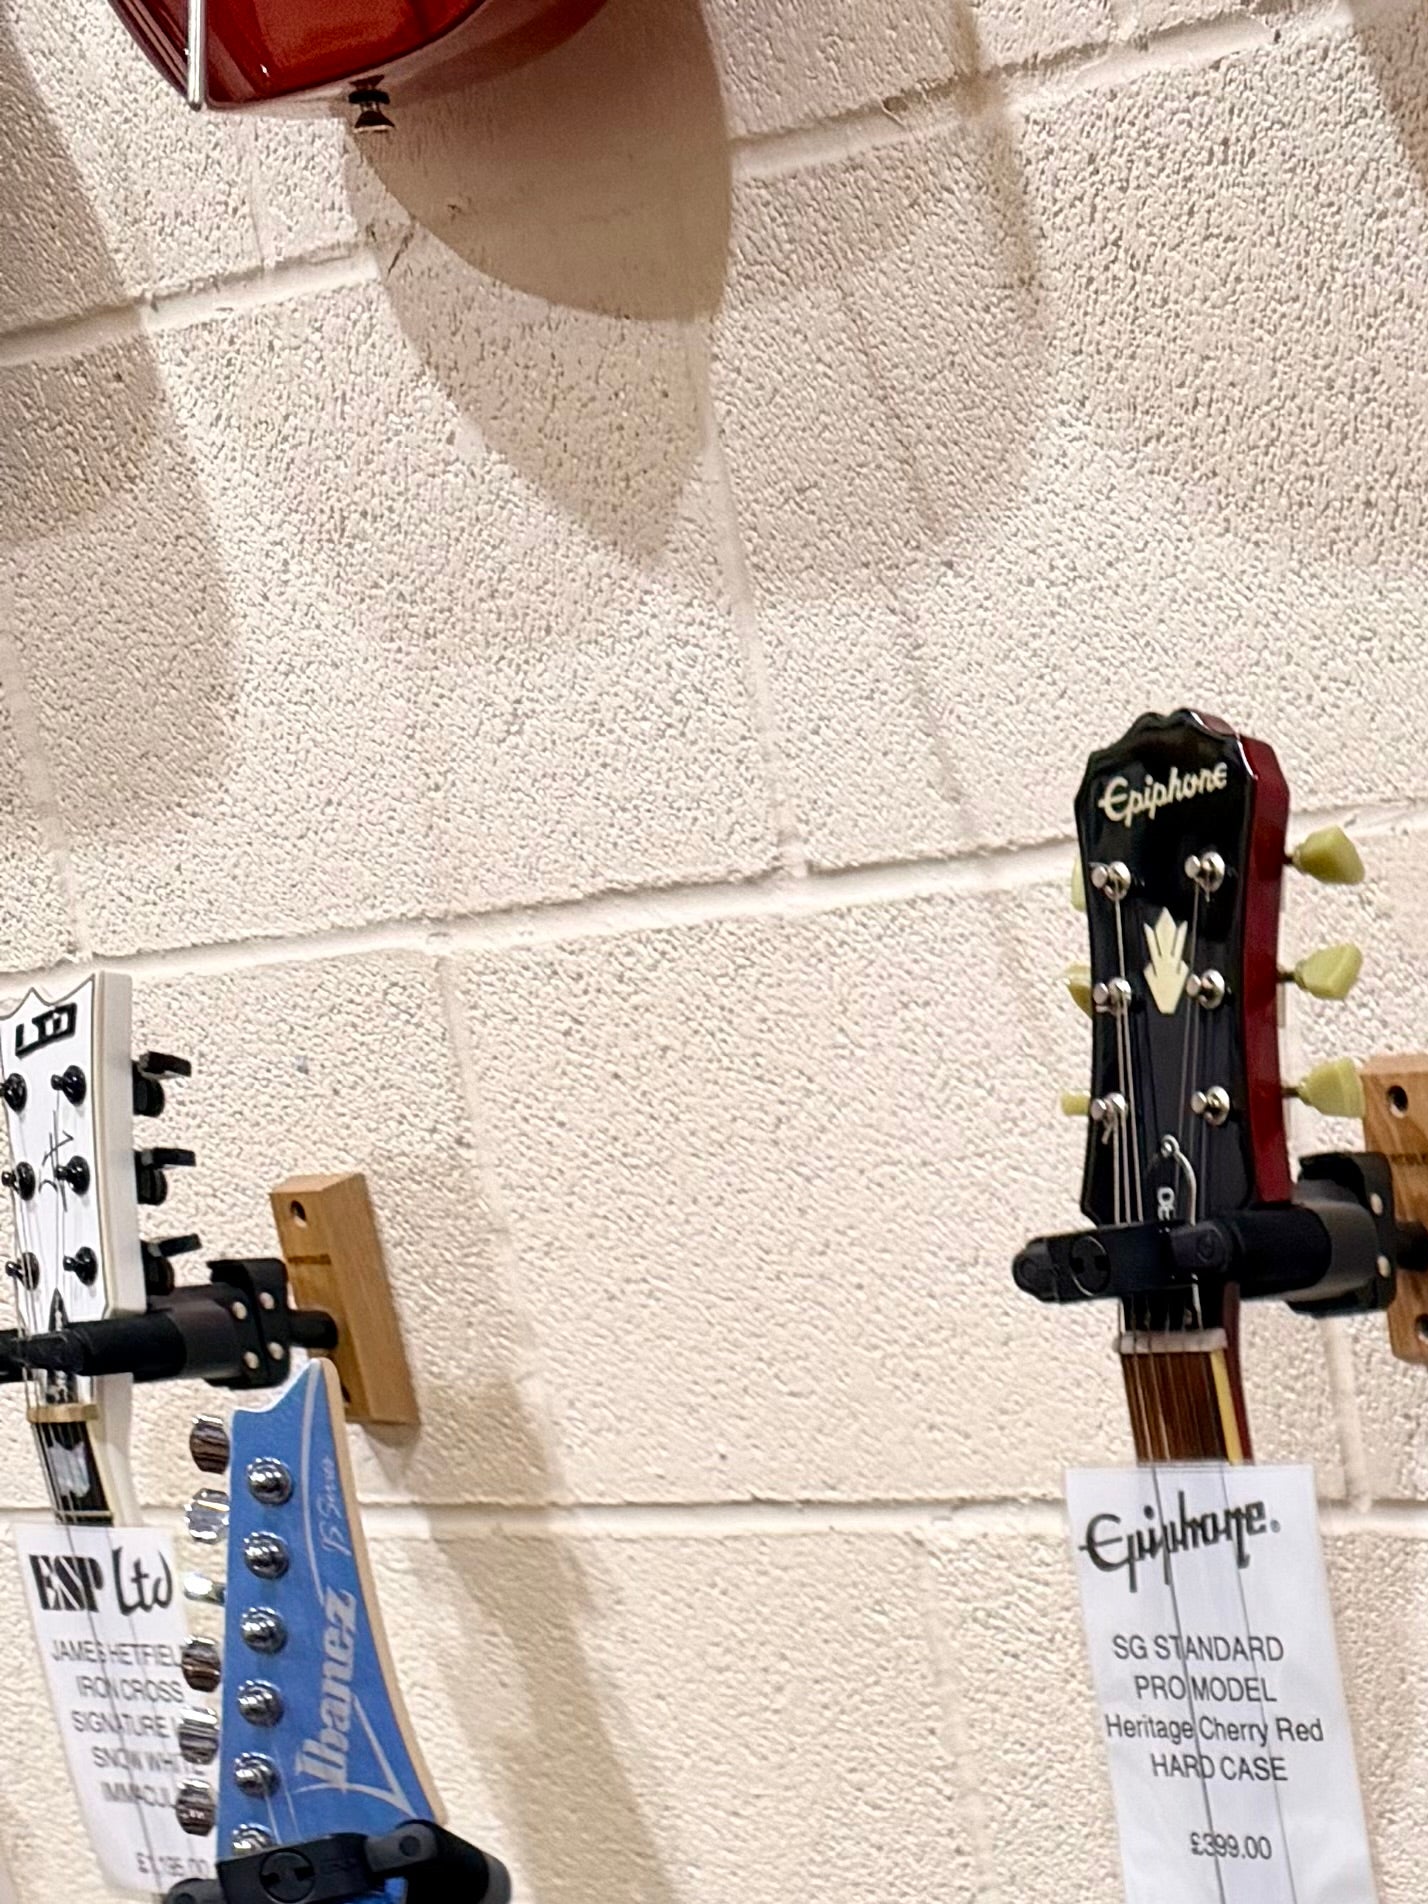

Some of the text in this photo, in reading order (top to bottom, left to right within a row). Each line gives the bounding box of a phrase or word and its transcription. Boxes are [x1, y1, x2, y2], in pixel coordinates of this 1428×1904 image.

[1098, 762, 1228, 827] Epiphone
[1079, 1490, 1268, 1593] Epiphone
[29, 1547, 173, 1617] ESP Ltd
[108, 1642, 183, 1668] HETFIEL
[1113, 1635, 1285, 1662] SG STANDARD
[120, 1678, 185, 1703] CROSS
[294, 1585, 357, 1795] Ibanez
[1134, 1675, 1278, 1703] PRO MODEL
[71, 1710, 170, 1738] SIGNATURE
[1106, 1714, 1325, 1748] Heritage Cherry Red
[1151, 1754, 1289, 1782] HARD CASE
[102, 1781, 176, 1808] IMMACUL
[1189, 1833, 1273, 1861] £399.00
